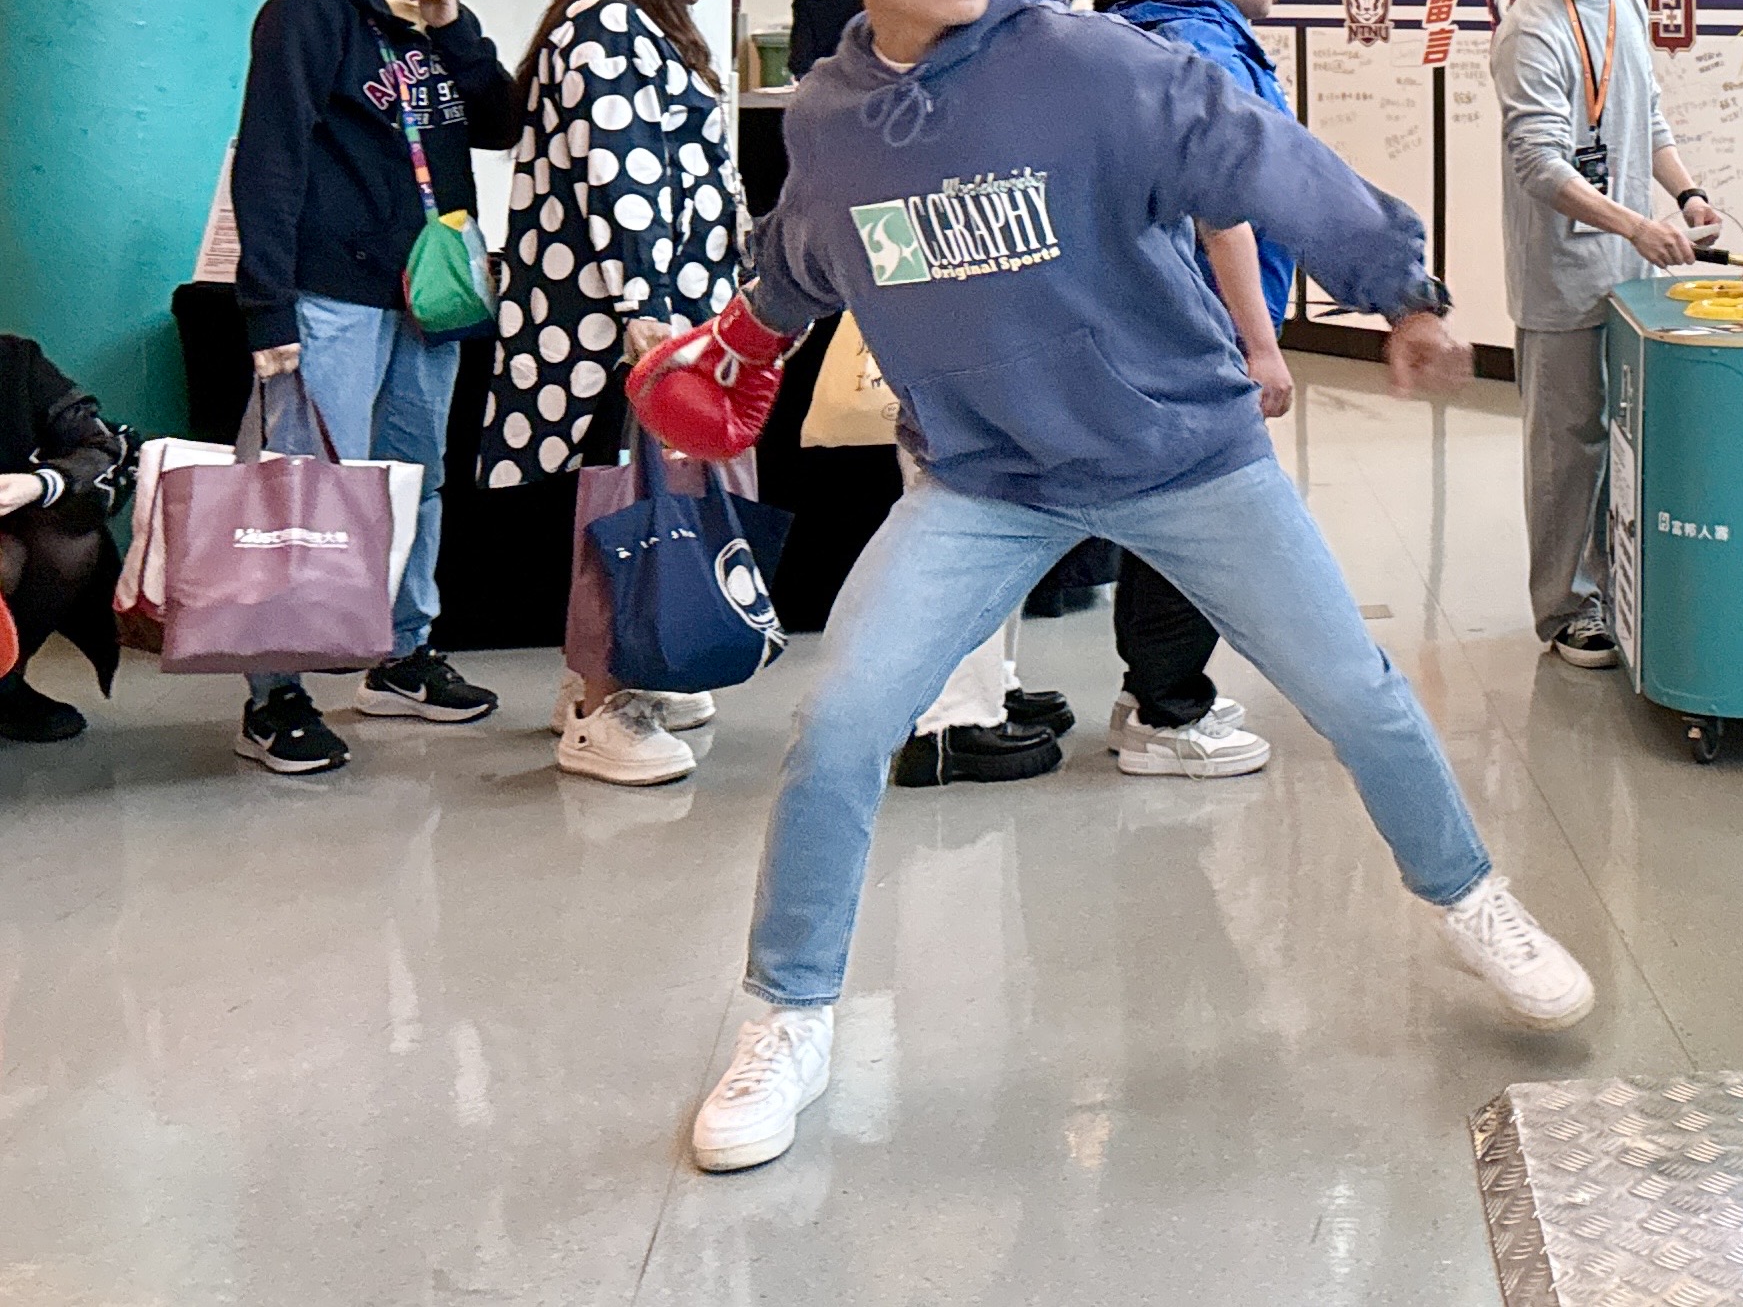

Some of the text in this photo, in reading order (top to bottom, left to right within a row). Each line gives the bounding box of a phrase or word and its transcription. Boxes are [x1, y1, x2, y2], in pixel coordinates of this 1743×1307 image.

[1348, 24, 1390, 43] NTNU
[931, 244, 1061, 281] Original Sports
